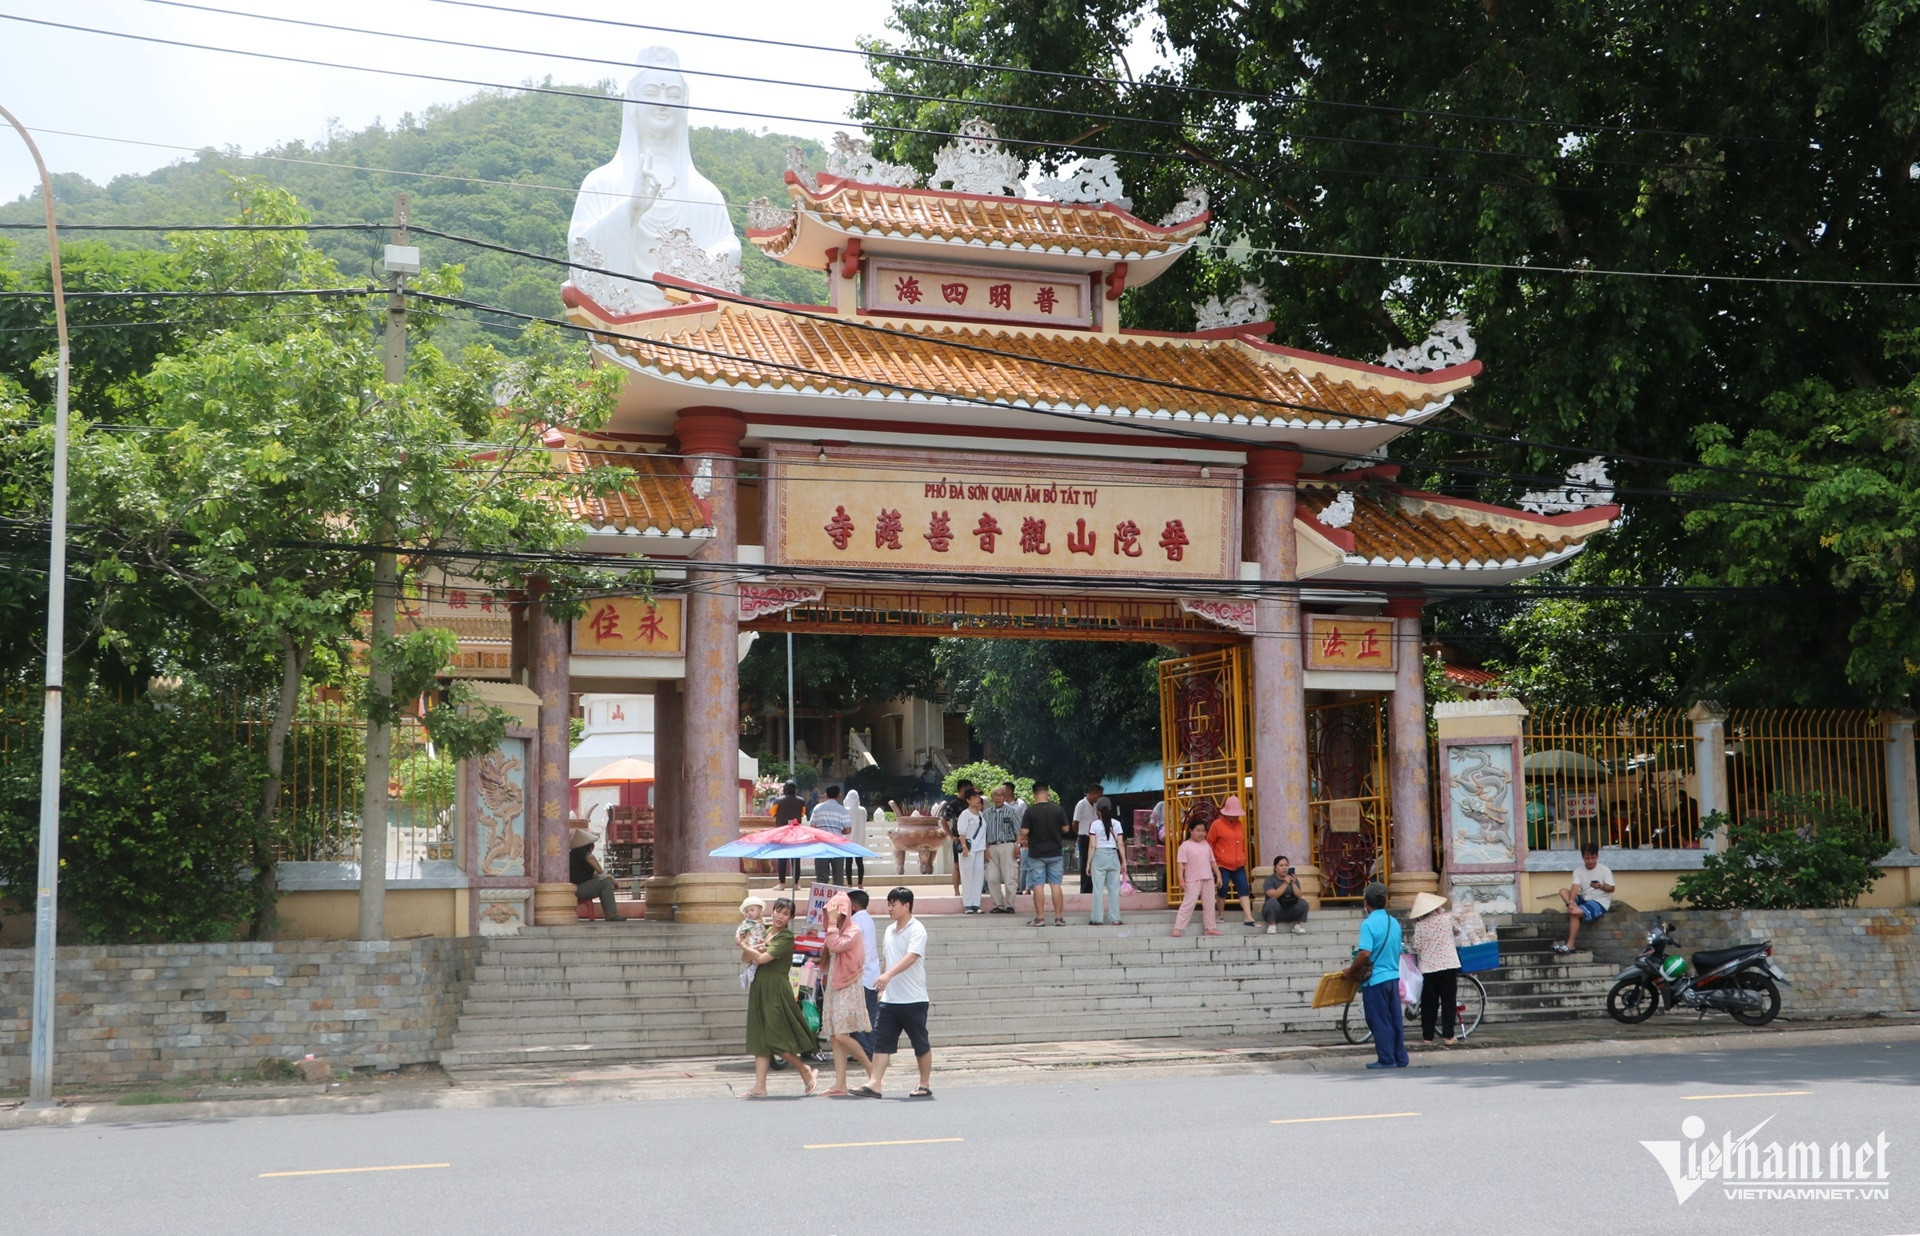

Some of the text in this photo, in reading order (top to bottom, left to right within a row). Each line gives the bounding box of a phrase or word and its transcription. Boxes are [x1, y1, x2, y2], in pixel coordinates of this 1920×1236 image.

[967, 484, 989, 501] SƠN
[992, 486, 1023, 504] QUAN
[1023, 483, 1041, 503] ÂM
[1060, 485, 1081, 505] TÁT
[1082, 488, 1098, 509] TỰ
